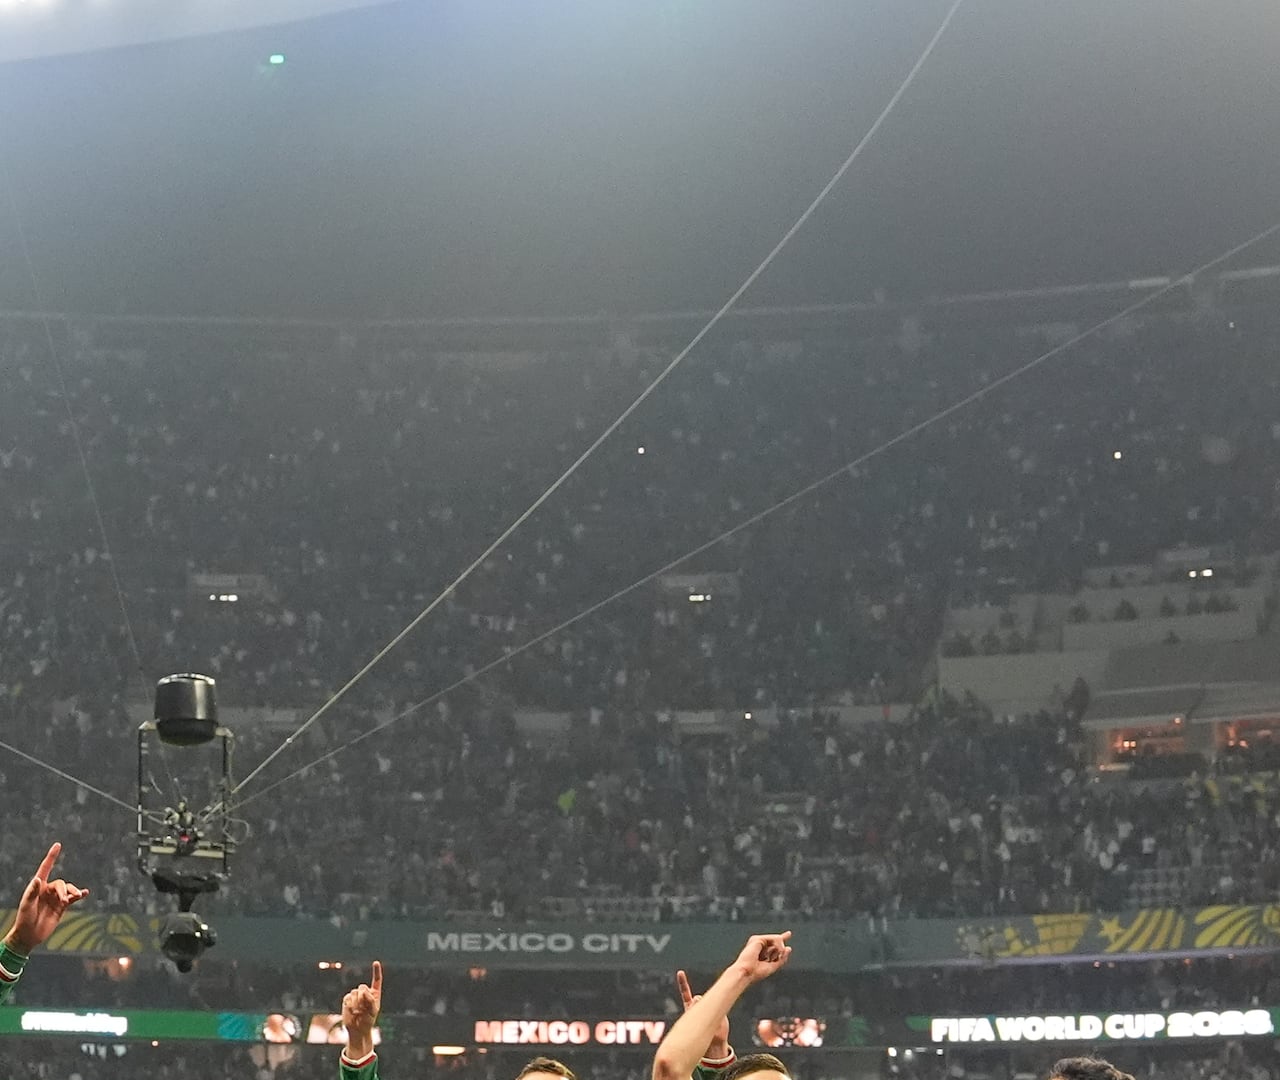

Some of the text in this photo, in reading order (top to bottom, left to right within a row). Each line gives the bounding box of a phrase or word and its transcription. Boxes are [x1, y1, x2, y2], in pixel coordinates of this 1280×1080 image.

[427, 932, 671, 952] MEXICO CITY
[475, 1020, 666, 1044] MEXICO CITY
[931, 1017, 995, 1042] FIFA
[995, 1014, 1103, 1041] WORLD
[1105, 1013, 1165, 1038] CUP
